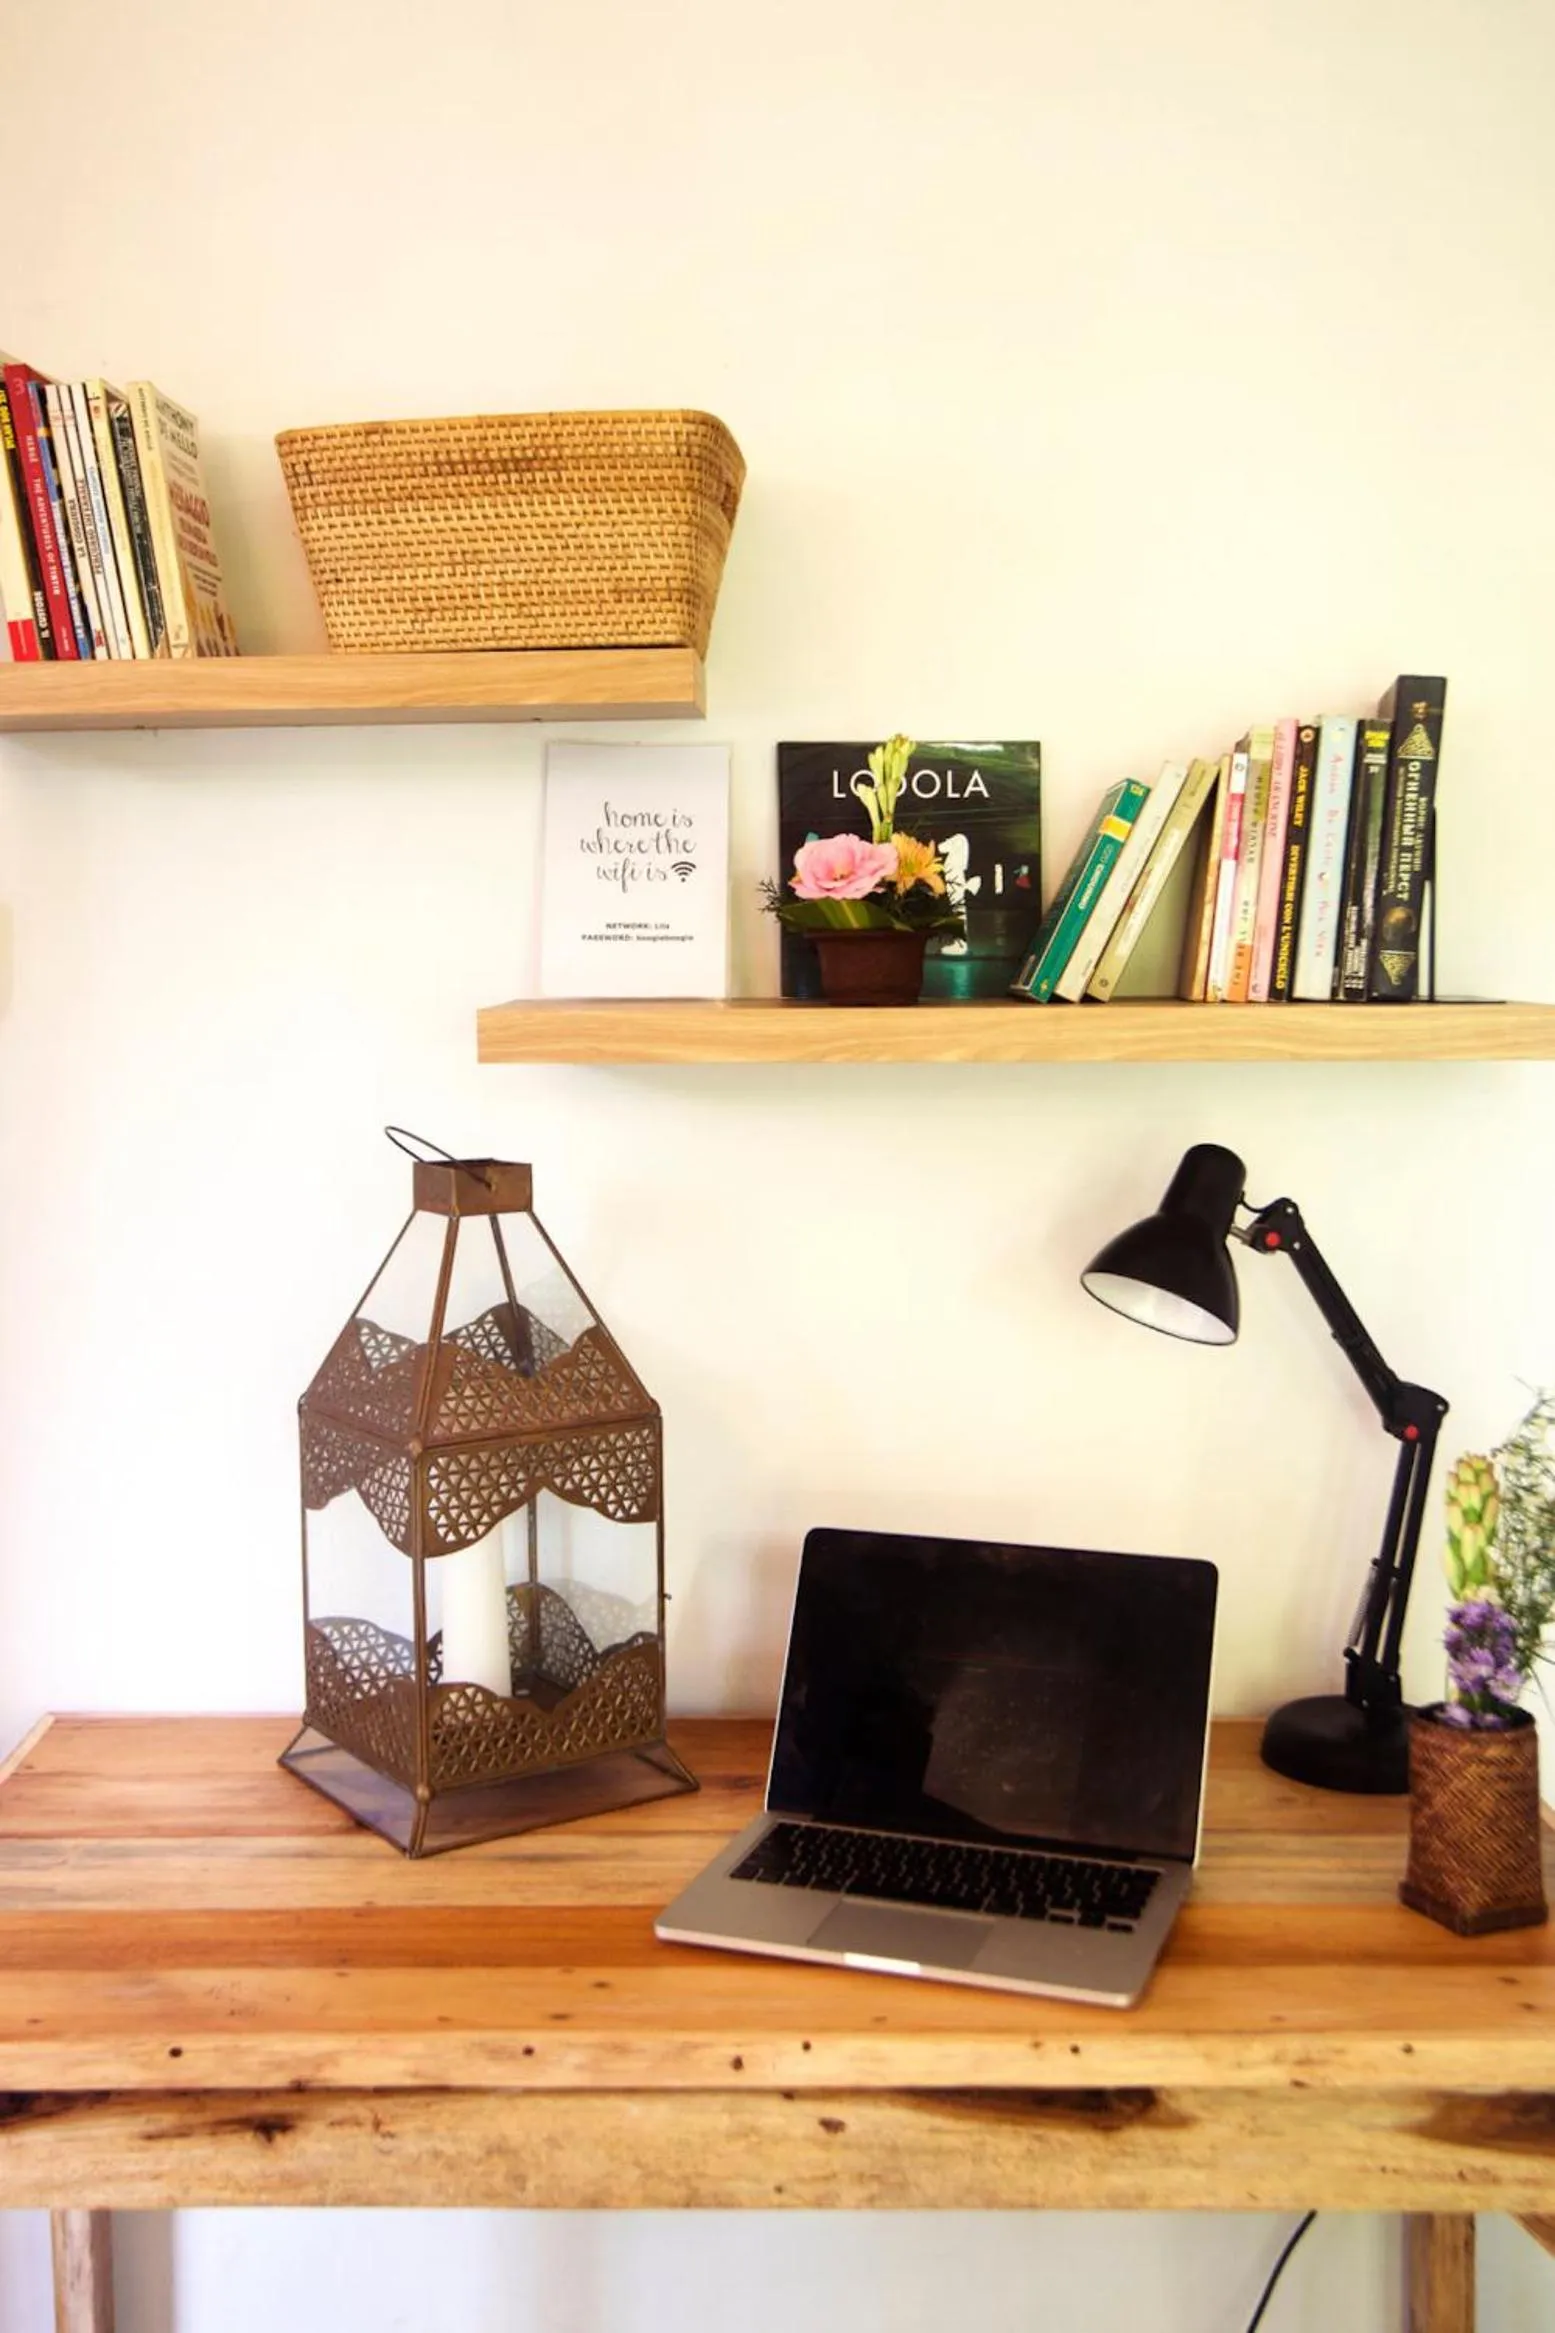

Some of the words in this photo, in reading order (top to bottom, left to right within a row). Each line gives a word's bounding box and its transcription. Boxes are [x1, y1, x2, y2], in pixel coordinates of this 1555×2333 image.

[32, 478, 43, 494] THE
[35, 496, 54, 550] ADVENTURES
[45, 552, 56, 563] OF
[48, 565, 62, 595] TINTIN
[34, 591, 48, 628] CUSTODE
[40, 629, 49, 638] IL
[1296, 765, 1309, 793] JACK
[604, 801, 666, 828] home
[672, 808, 693, 828] is
[1291, 794, 1306, 828] WILEY
[1401, 761, 1421, 846] ОГНЕННЫЙ
[580, 828, 648, 854] where
[651, 829, 697, 854] the
[596, 857, 638, 893] wifi
[646, 862, 667, 881] is
[1396, 853, 1413, 901] ПЕРСТ
[606, 922, 652, 930] NETWORK:
[1281, 903, 1294, 925] CON
[581, 934, 634, 942] PASSWORD:
[1273, 925, 1292, 990] L'UNICICLO
